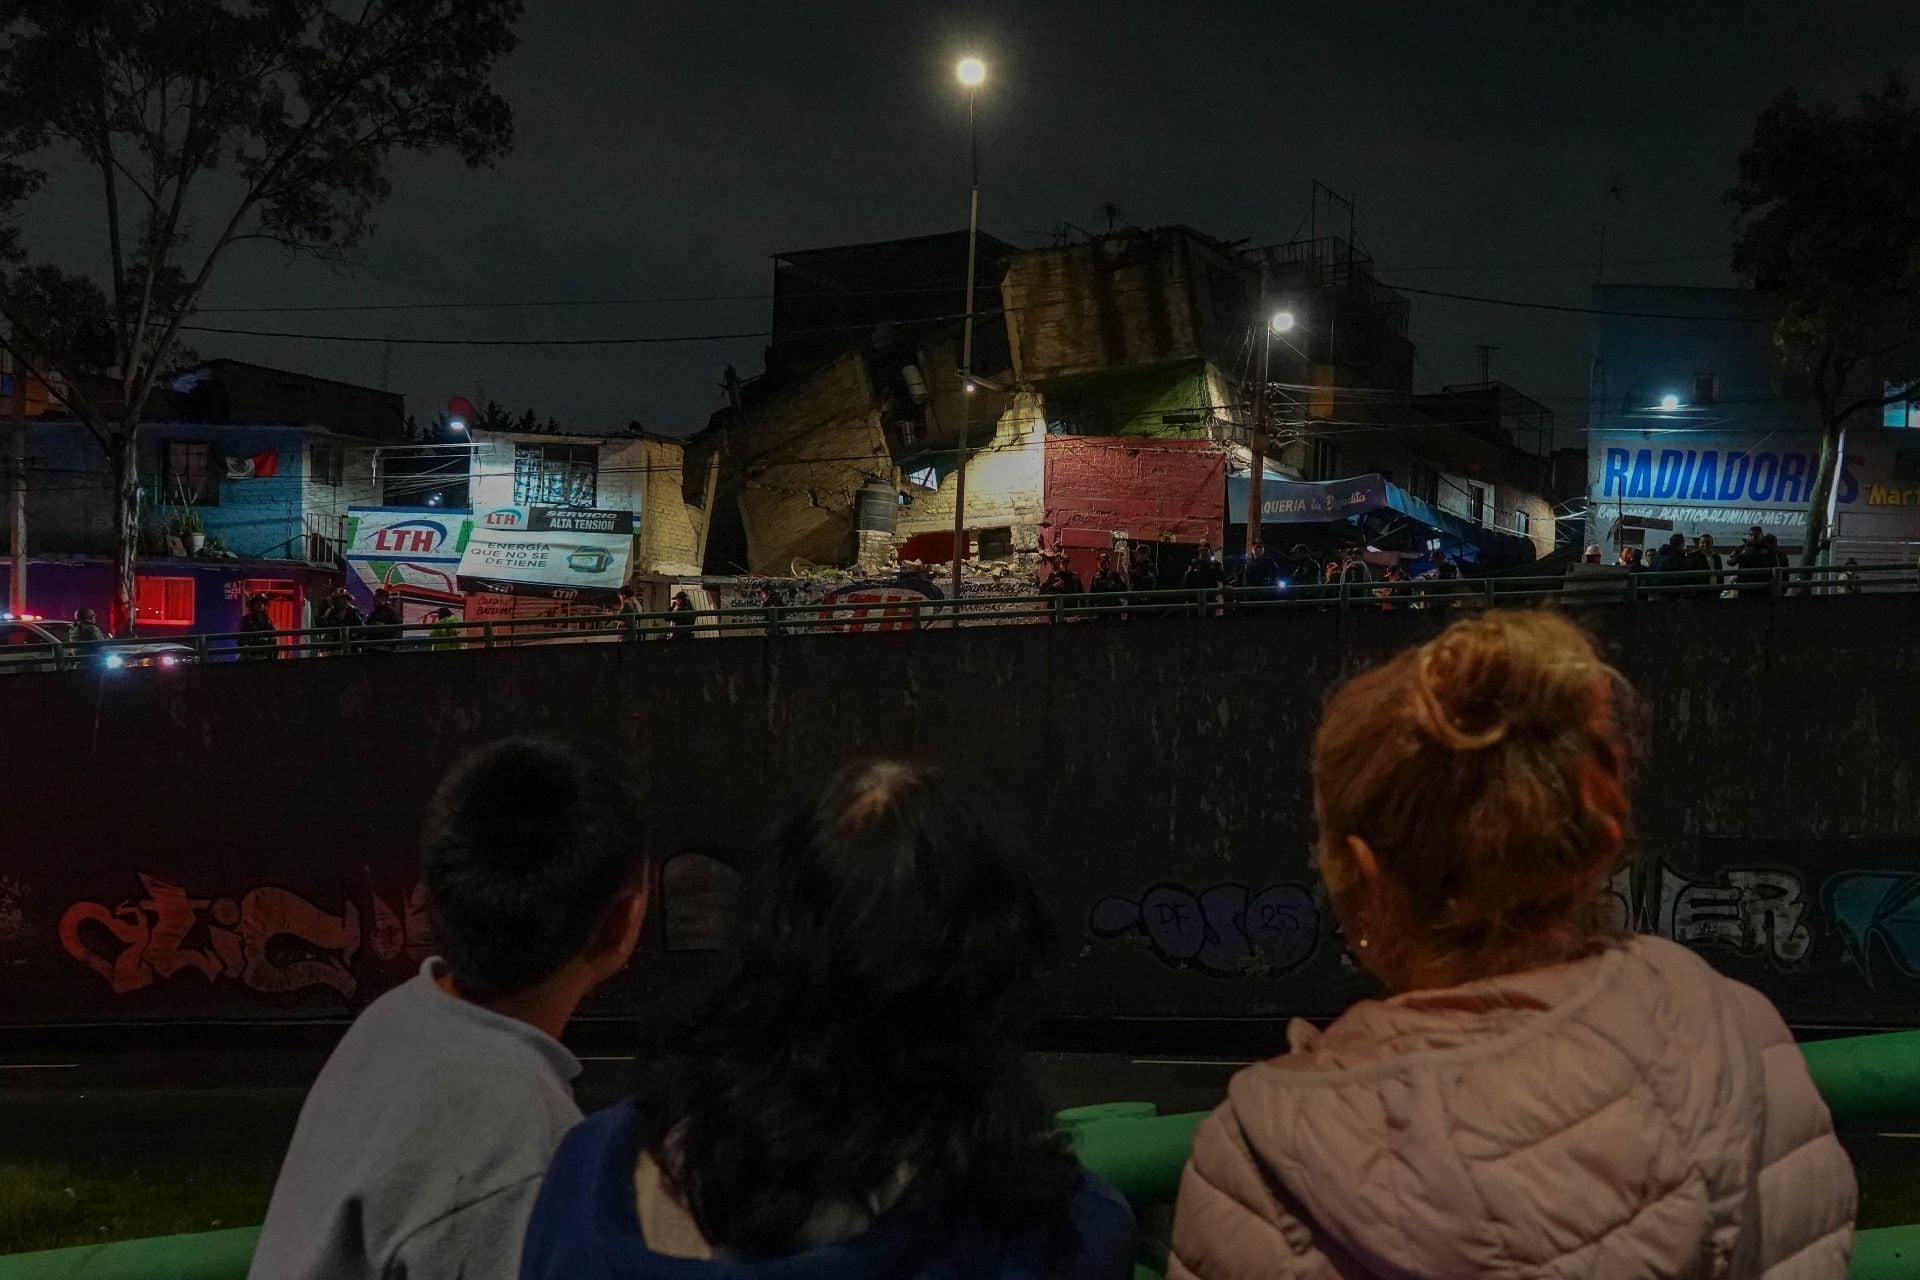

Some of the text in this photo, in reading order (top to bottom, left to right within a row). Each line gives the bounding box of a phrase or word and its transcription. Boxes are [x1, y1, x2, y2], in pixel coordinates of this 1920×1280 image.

[486, 513, 516, 526] LTH
[545, 510, 618, 519] SERVICIO
[549, 517, 573, 529] ALTA
[375, 529, 435, 552] LTH
[488, 541, 551, 551] ENERGÍA
[471, 548, 550, 560] QUE NO SE
[485, 557, 547, 568] DETIENE
[552, 590, 575, 599] LTH
[1260, 903, 1303, 934] 25
